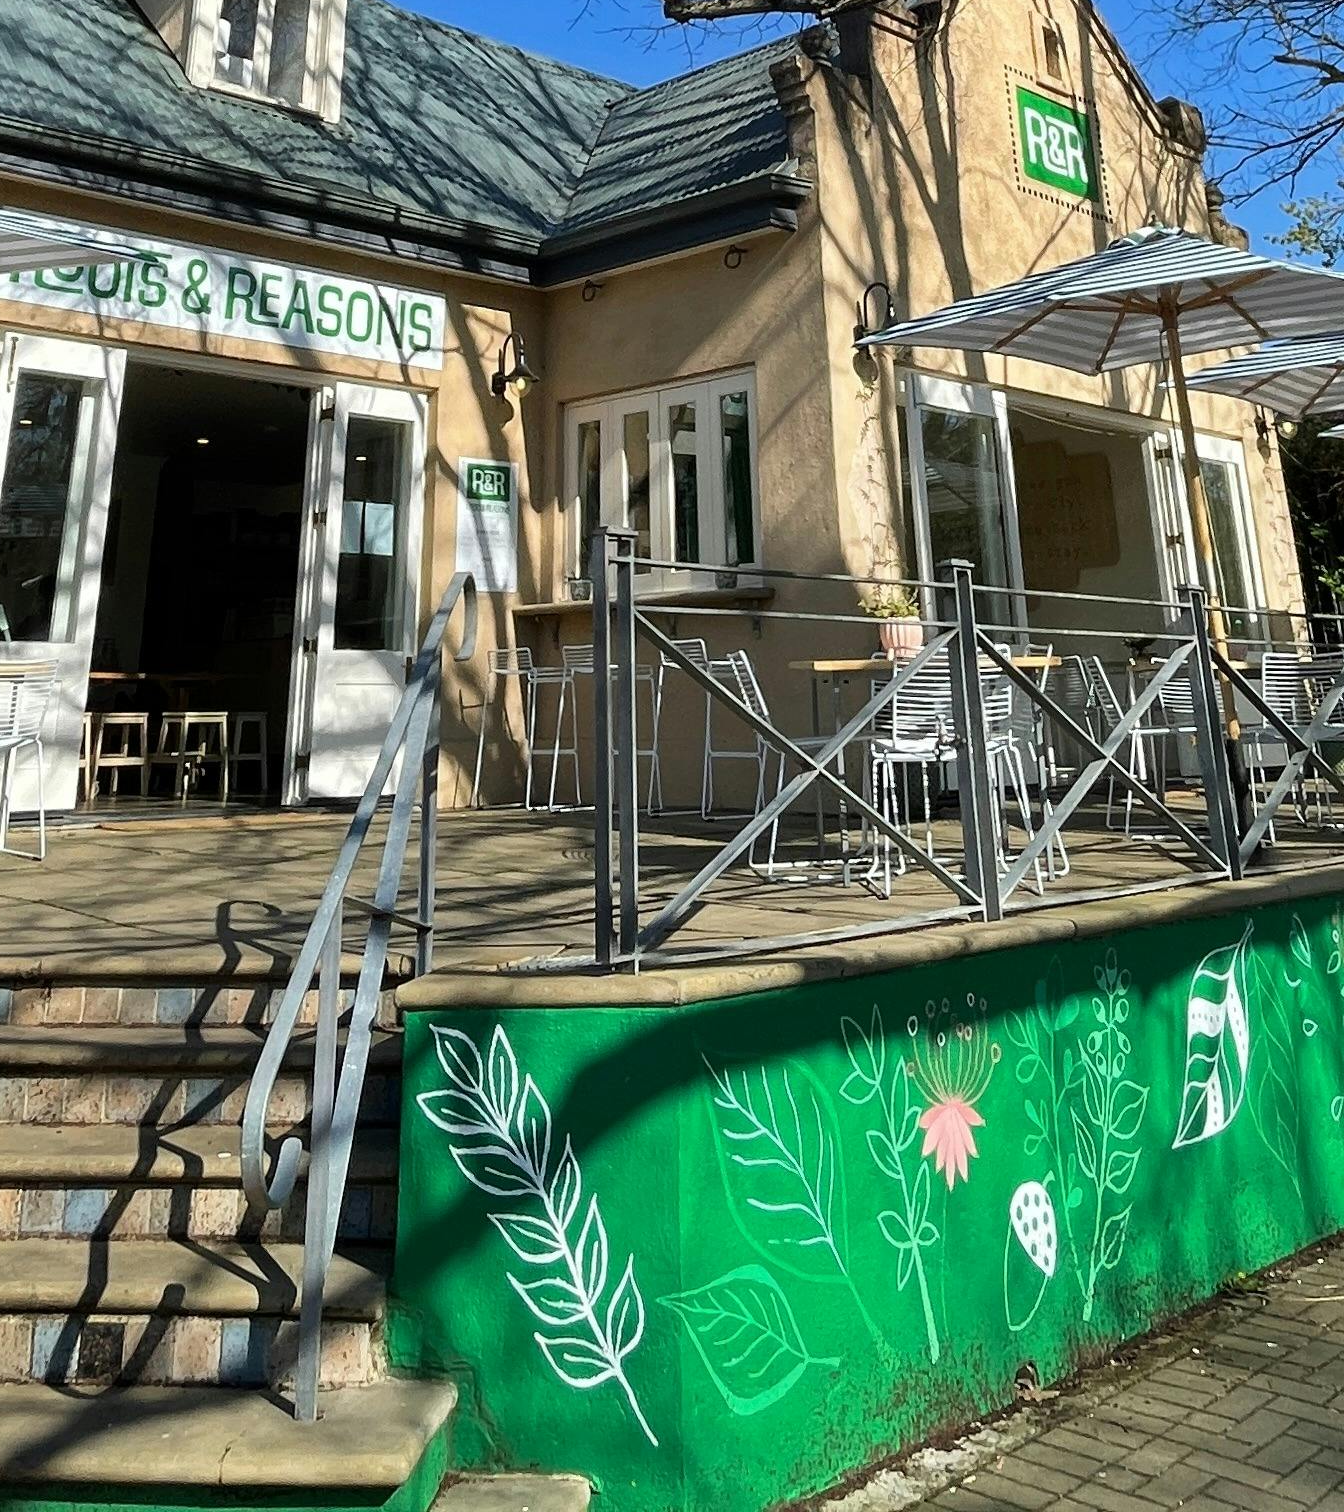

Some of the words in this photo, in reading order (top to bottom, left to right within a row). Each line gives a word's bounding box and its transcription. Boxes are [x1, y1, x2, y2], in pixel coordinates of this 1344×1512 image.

[1023, 106, 1089, 184] R&R
[181, 258, 212, 315] &
[224, 266, 433, 352] REASONS
[471, 468, 506, 496] R&R
